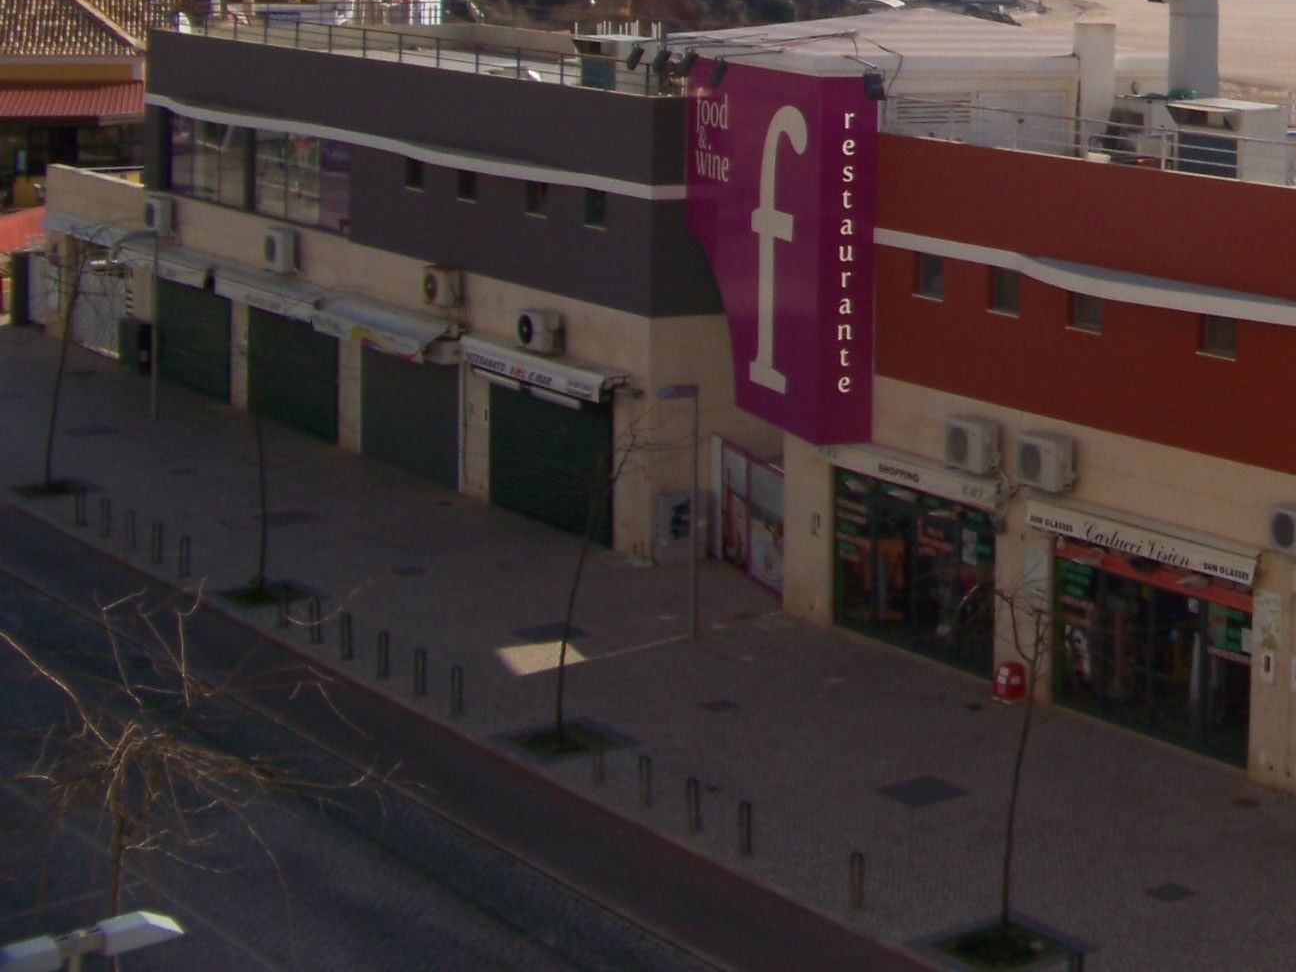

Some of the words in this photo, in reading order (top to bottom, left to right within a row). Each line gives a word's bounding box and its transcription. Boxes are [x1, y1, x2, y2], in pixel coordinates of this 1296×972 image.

[696, 90, 729, 133] food
[695, 147, 730, 183] wine
[749, 105, 808, 395] f
[837, 111, 856, 394] restaurante
[878, 463, 919, 482] SHOPPING
[1044, 518, 1073, 532] GLASSES
[1148, 541, 1191, 567] Vision
[1219, 565, 1250, 581] GLASSES
